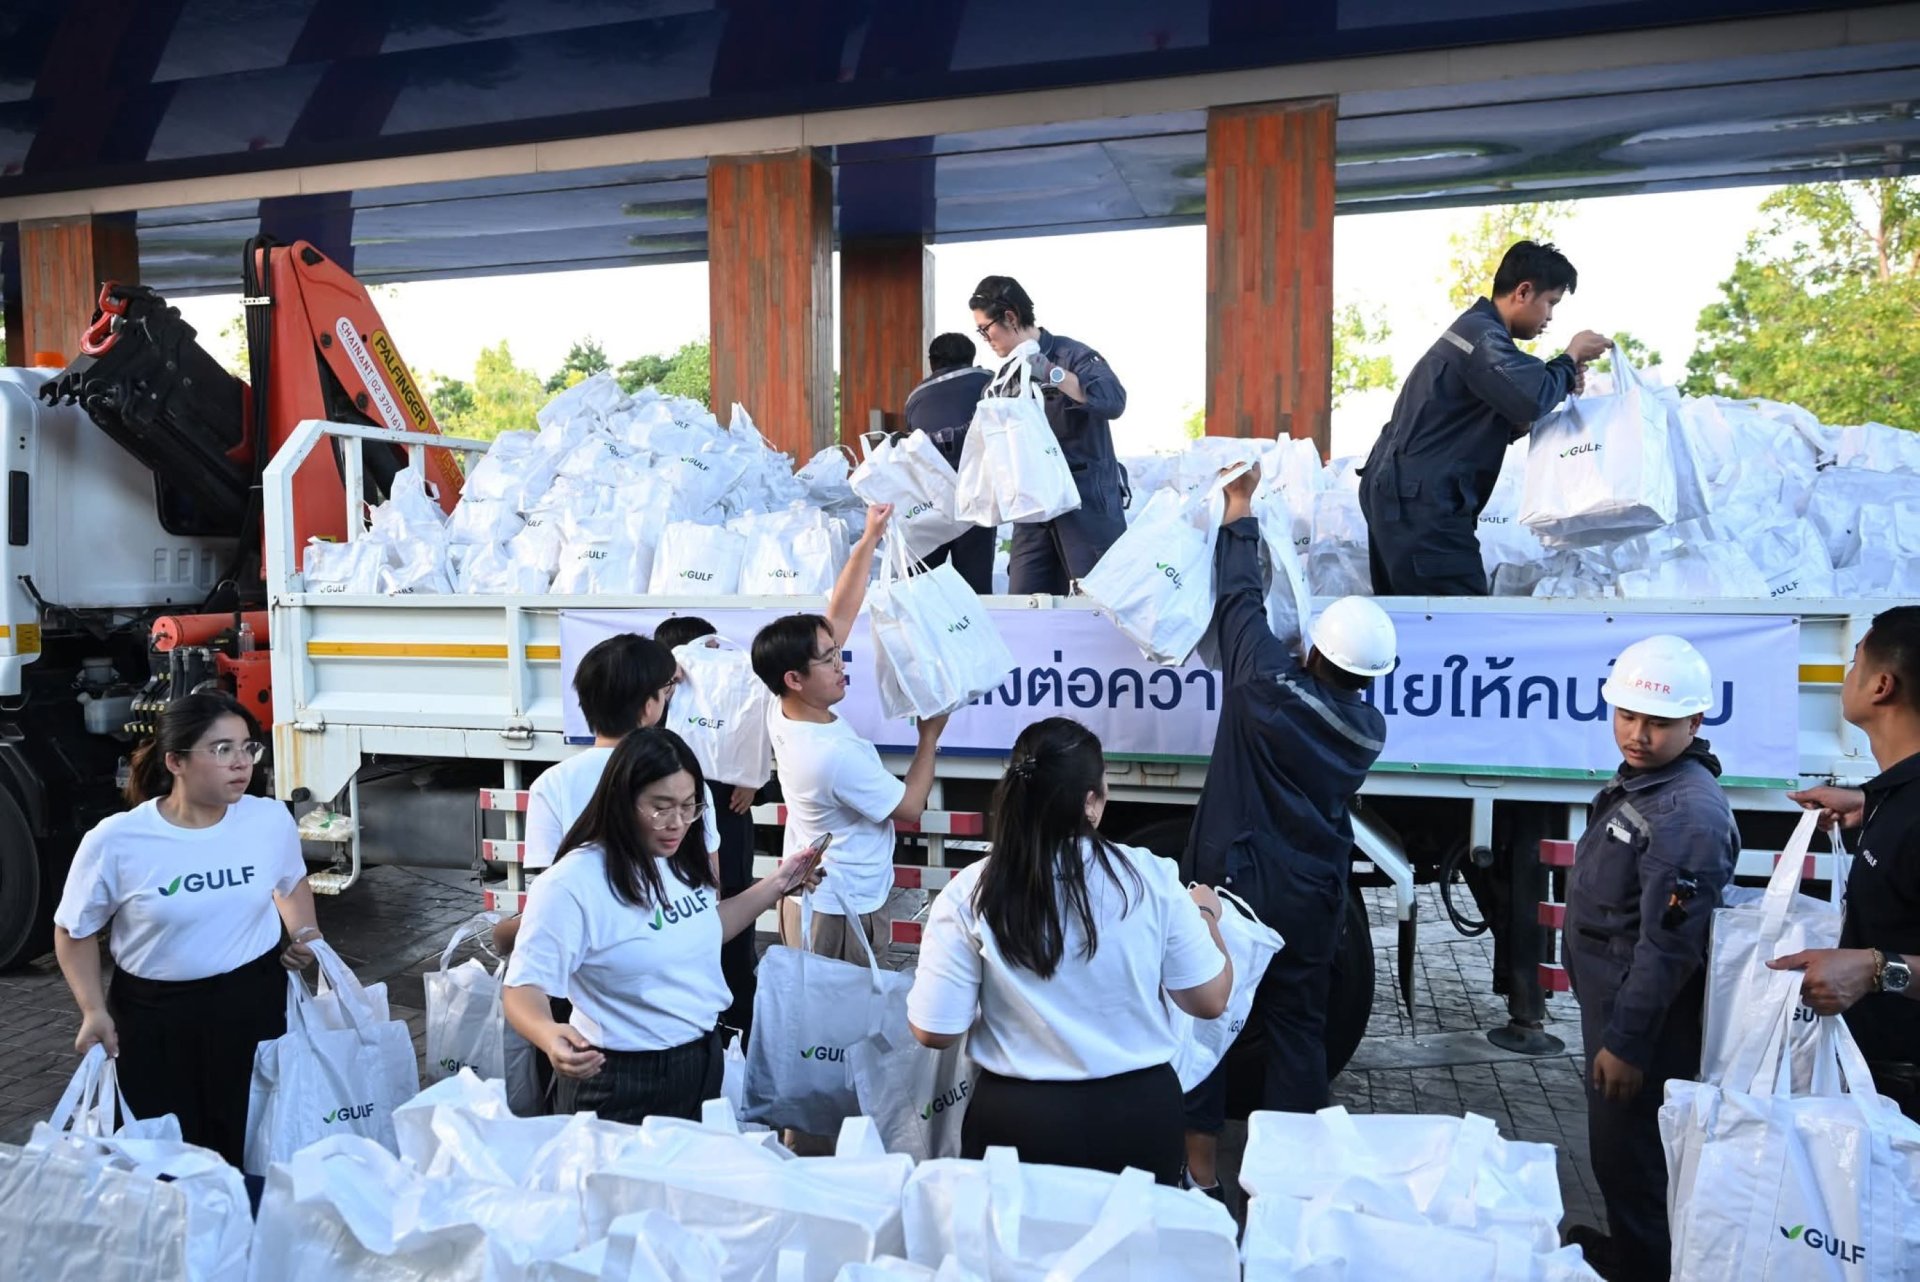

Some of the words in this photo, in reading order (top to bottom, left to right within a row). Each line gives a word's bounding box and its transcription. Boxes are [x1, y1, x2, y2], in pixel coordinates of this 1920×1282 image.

[341, 321, 374, 377] CHAINANT
[375, 336, 427, 426] PALFINGER
[1570, 443, 1602, 456] GULF
[687, 570, 714, 582] GULF
[1635, 679, 1671, 695] PRTR
[184, 865, 255, 893] GULF
[663, 889, 708, 924] GULF
[337, 1103, 374, 1122] GULF
[932, 1080, 969, 1114] GULF
[1804, 1227, 1866, 1265] GULF
